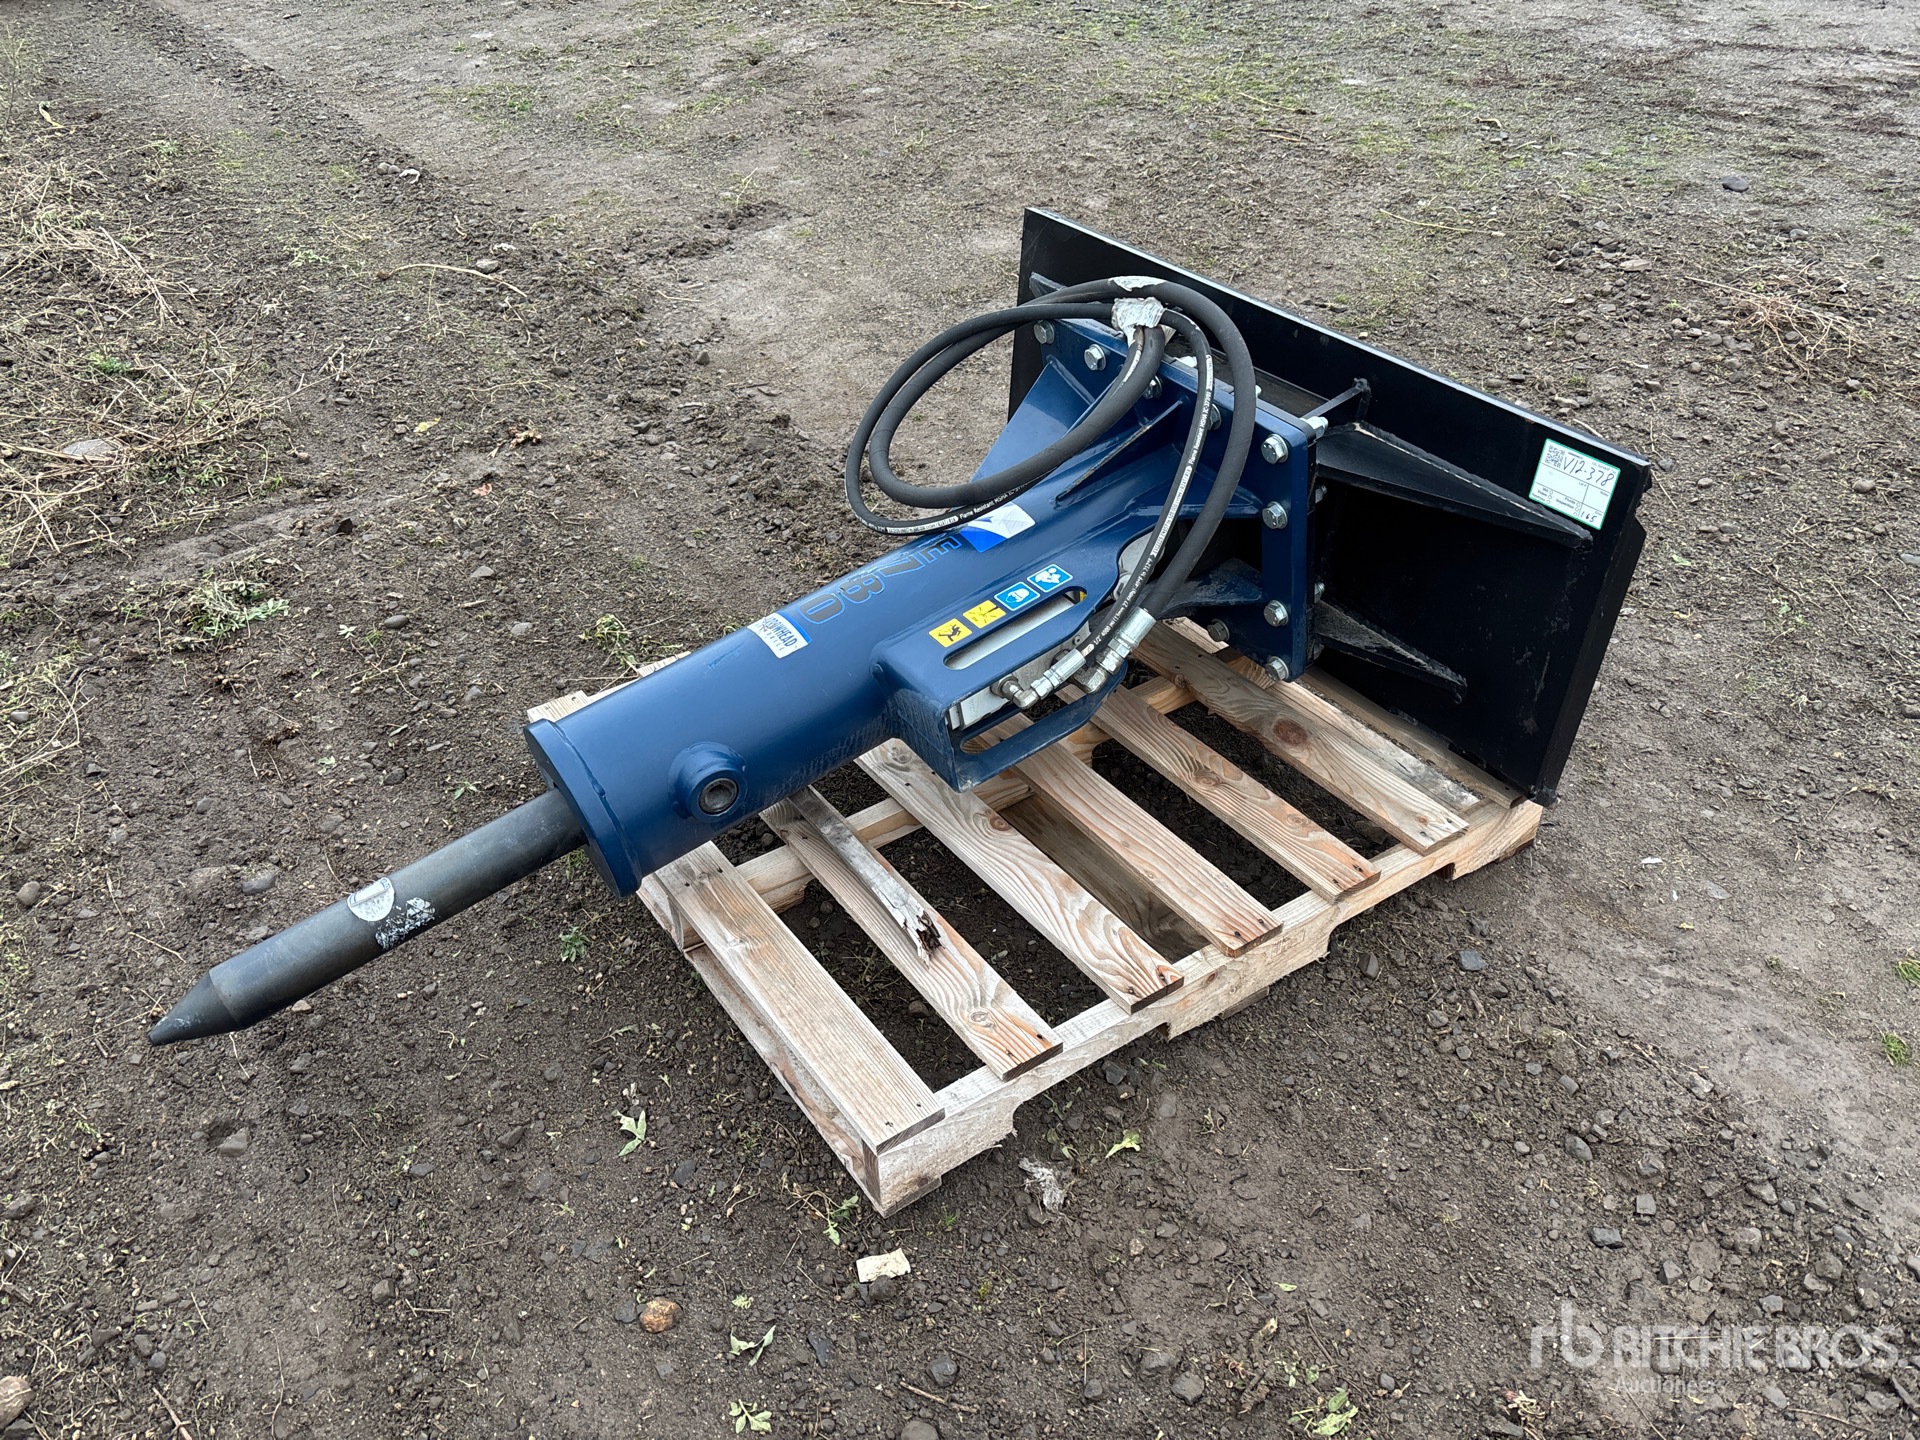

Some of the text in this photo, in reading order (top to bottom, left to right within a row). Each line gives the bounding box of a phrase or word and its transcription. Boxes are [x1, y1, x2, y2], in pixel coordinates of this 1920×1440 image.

[1188, 449, 1198, 464] Flame
[1193, 427, 1205, 450] Resistant
[1563, 456, 1615, 487] V12-378
[959, 510, 974, 520] Flame
[973, 500, 995, 514] Resistant
